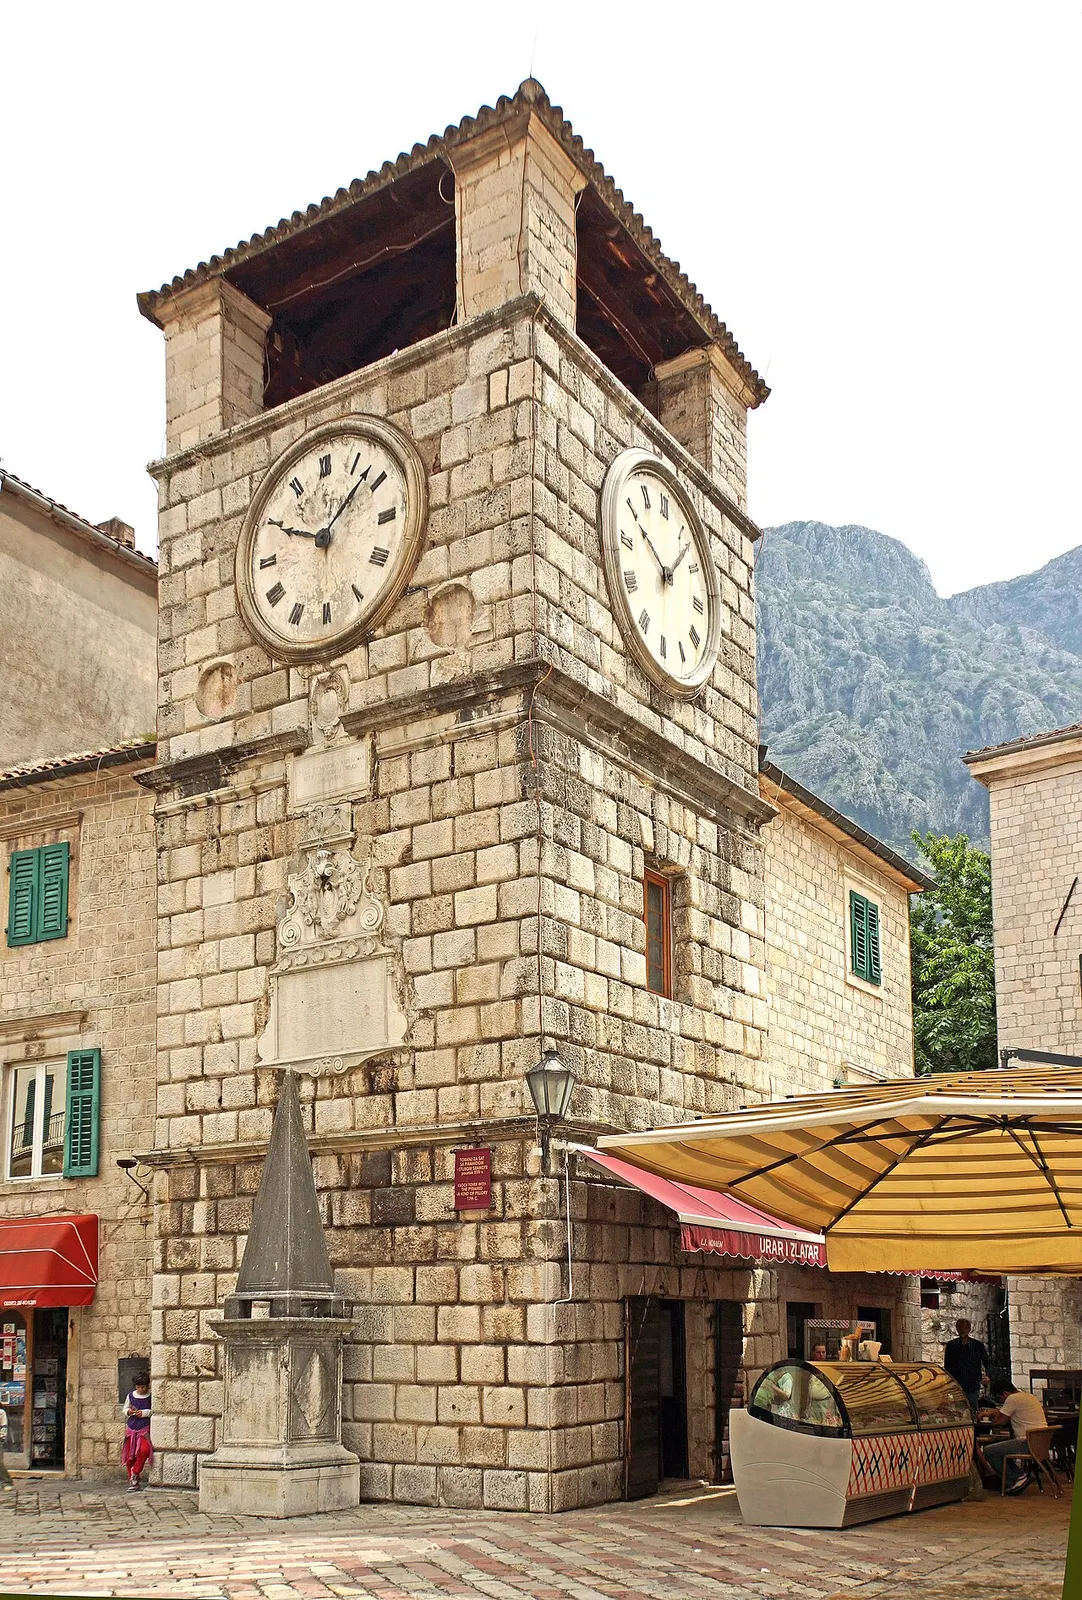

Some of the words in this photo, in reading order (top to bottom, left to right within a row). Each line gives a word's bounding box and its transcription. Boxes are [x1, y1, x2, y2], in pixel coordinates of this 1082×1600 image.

[370, 470, 388, 493] II
[377, 506, 397, 525] III
[692, 595, 704, 615] III
[759, 1237, 784, 1256] URAR
[785, 1242, 789, 1257] I
[790, 1242, 819, 1261] ZLATAR
